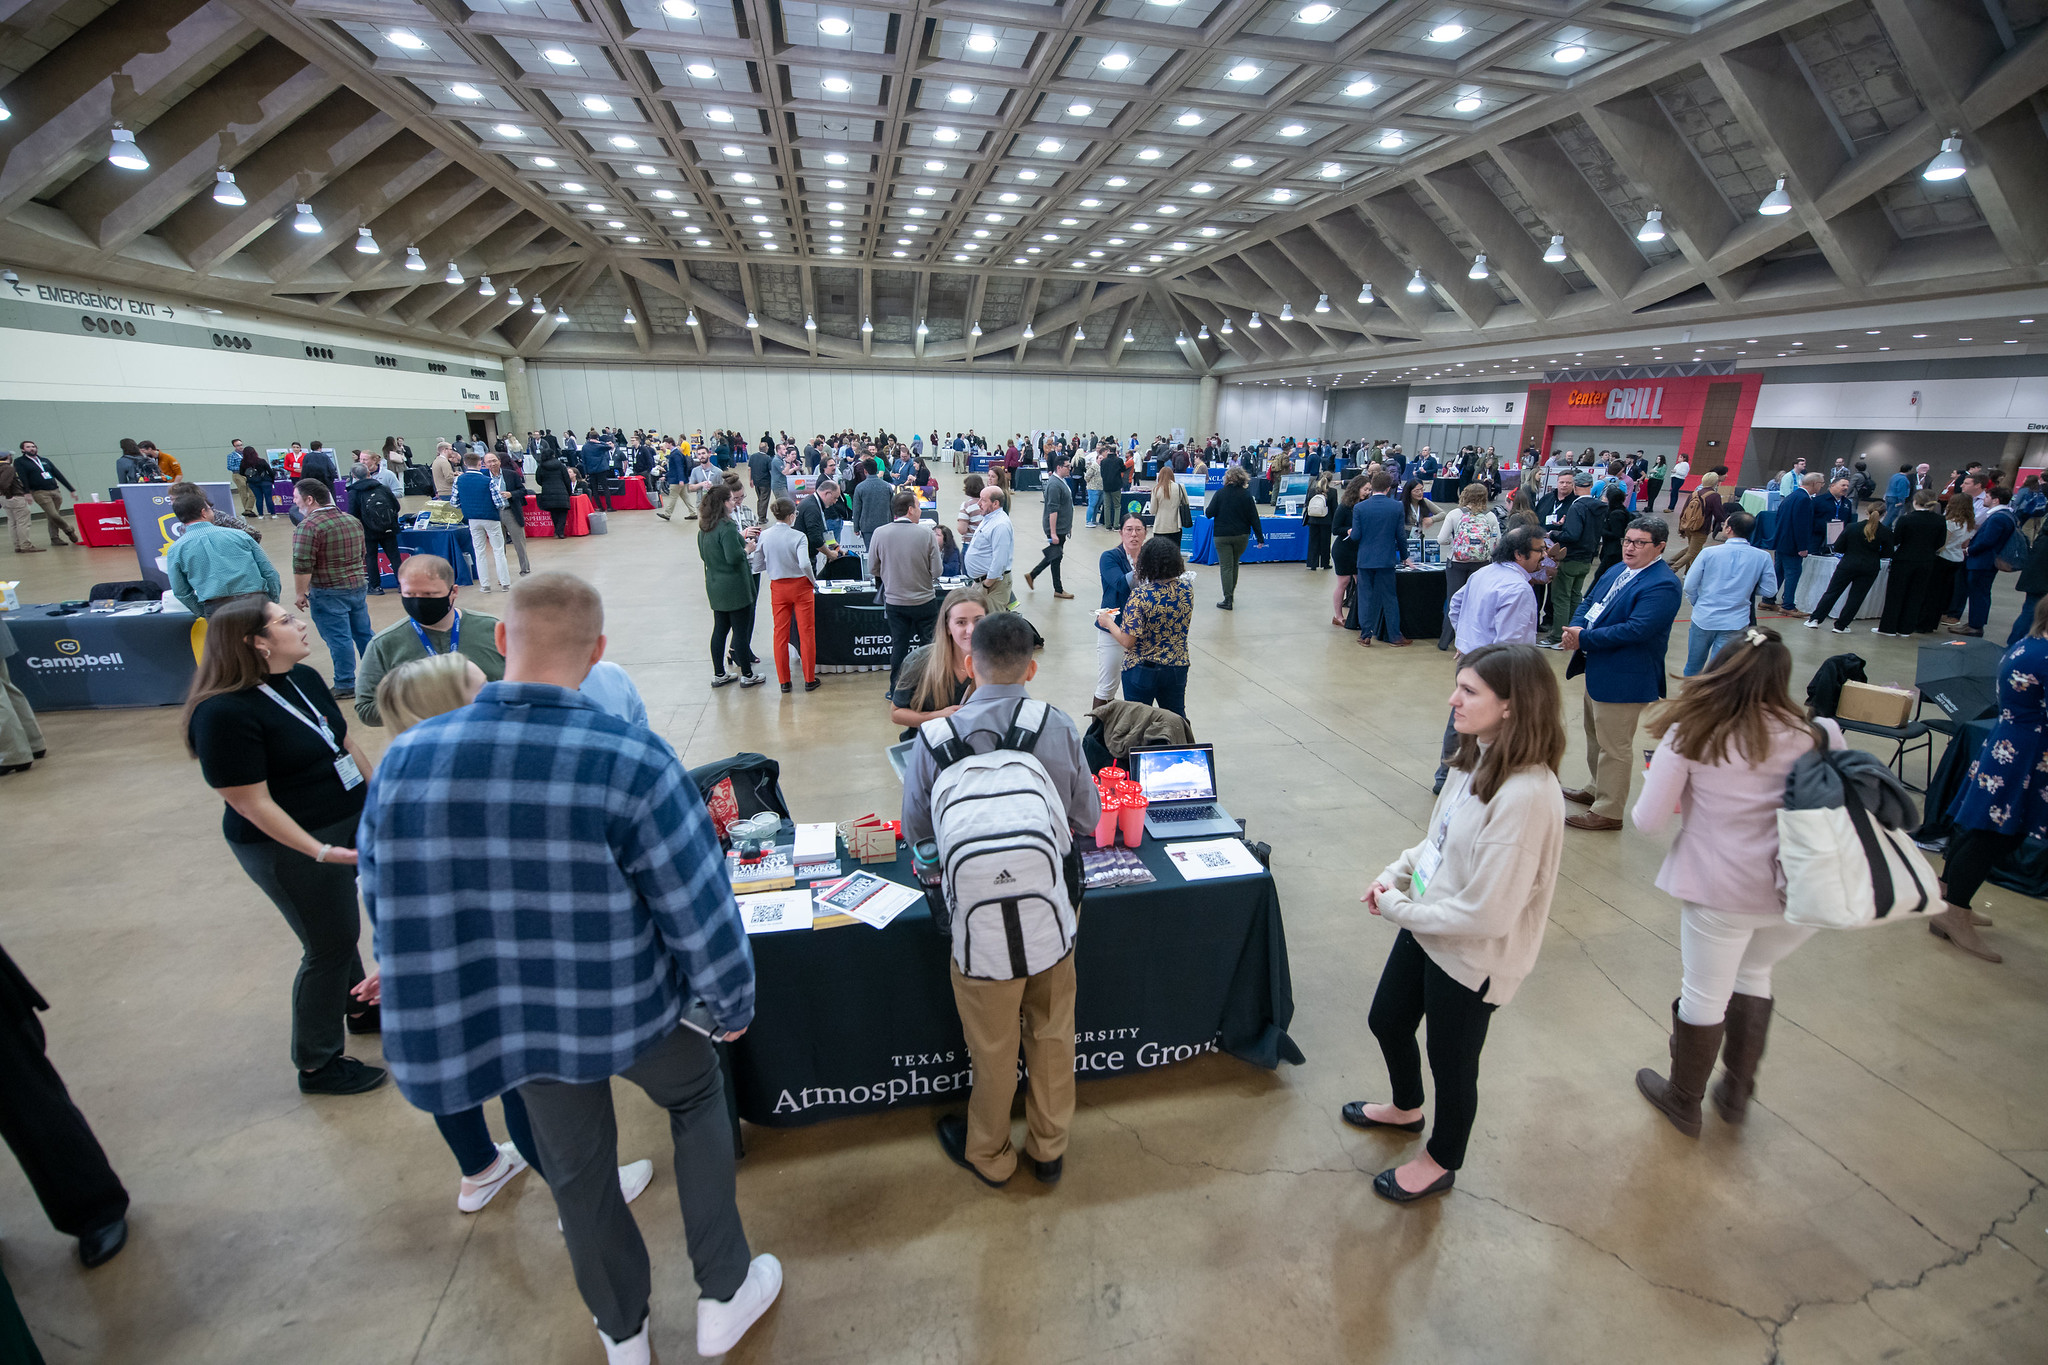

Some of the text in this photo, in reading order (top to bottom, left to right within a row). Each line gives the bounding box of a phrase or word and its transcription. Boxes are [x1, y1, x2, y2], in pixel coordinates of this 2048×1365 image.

[36, 284, 156, 317] EMERGENCY EXIT
[1435, 405, 1490, 414] Sharp Street Lobby
[1568, 386, 1664, 419] Center GRILL
[61, 642, 76, 650] CS
[853, 646, 893, 656] CLIMAT
[26, 652, 124, 668] Campbell
[891, 1050, 955, 1067] TEXAS
[1074, 1027, 1140, 1044] ERSITY
[772, 1063, 974, 1114] Atmospheri
